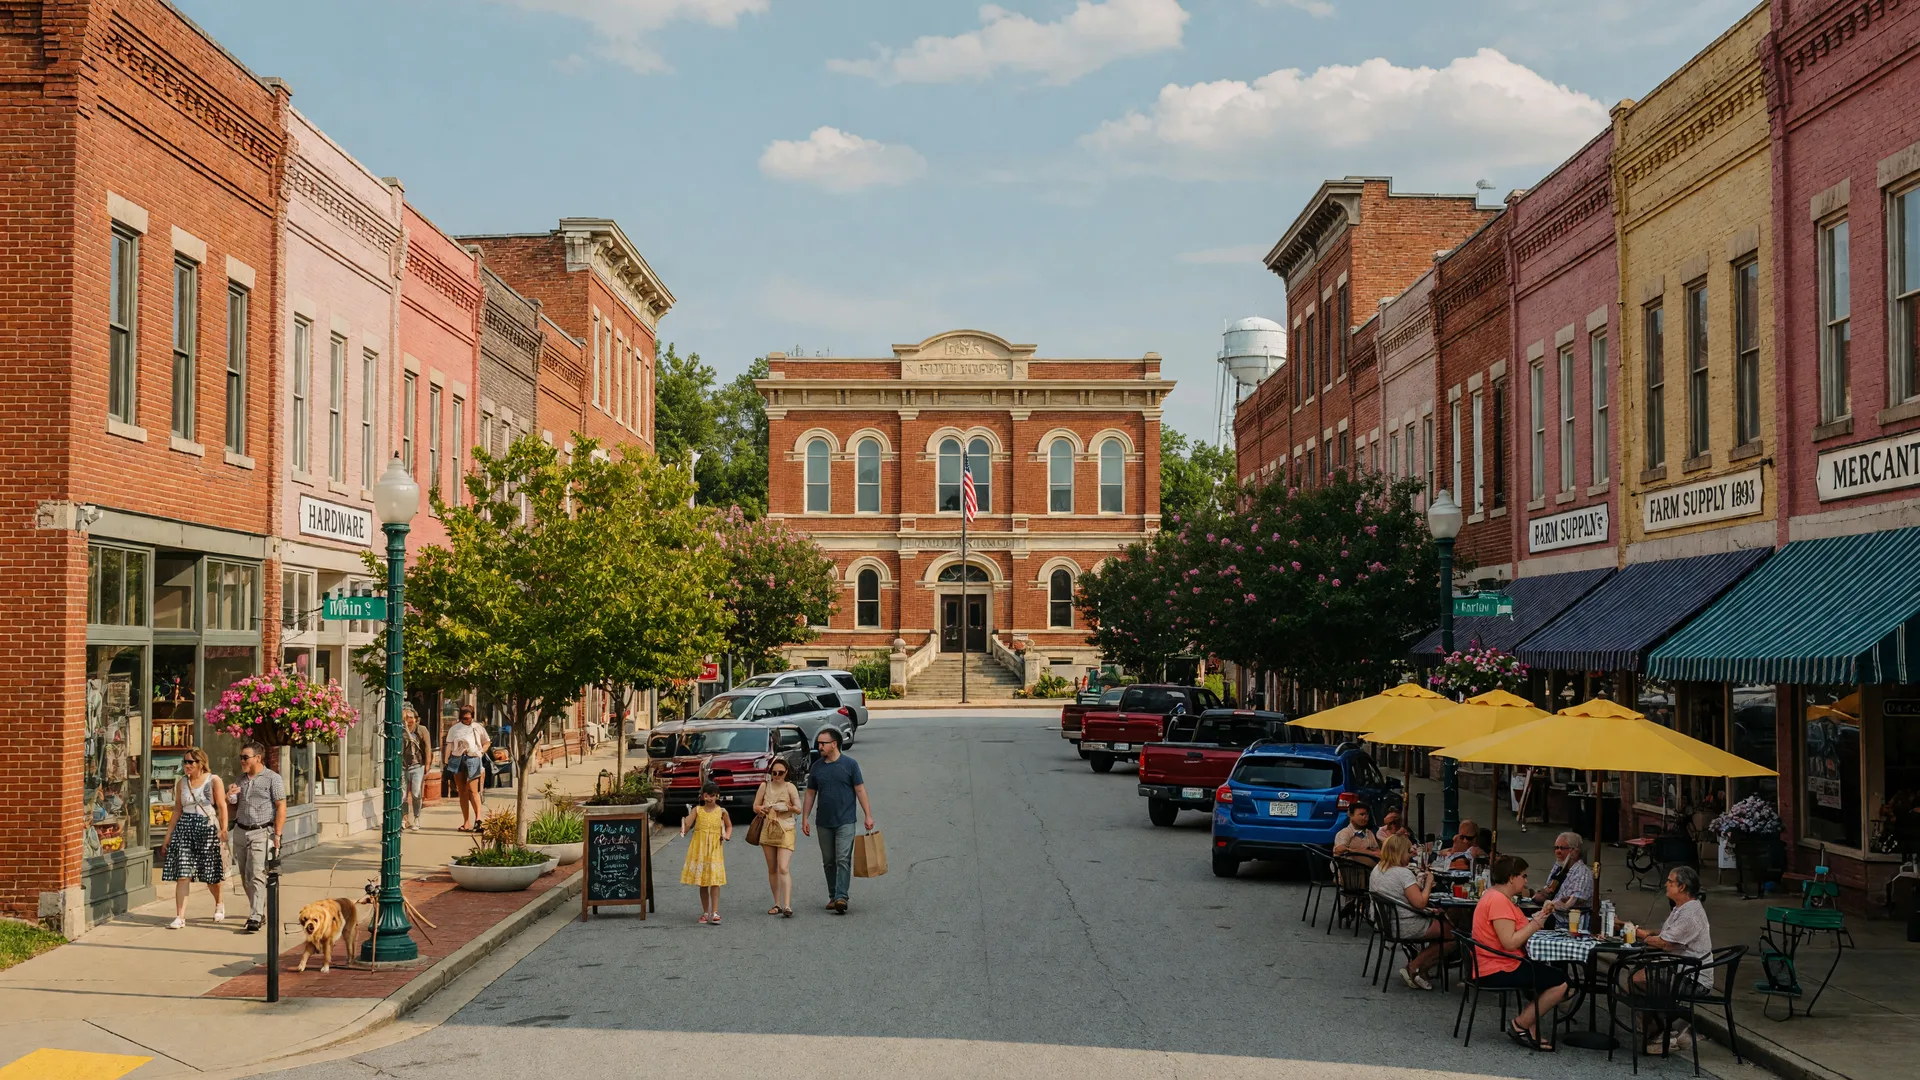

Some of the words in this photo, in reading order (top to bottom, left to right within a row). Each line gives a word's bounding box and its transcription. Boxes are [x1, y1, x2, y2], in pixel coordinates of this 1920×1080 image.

[1833, 442, 1920, 490] MERCANT
[1649, 494, 1680, 523] FARM
[1683, 484, 1728, 516] SUPPLY
[1731, 479, 1755, 508] 1893
[308, 504, 364, 538] HARDWARE
[330, 599, 361, 616] Main
